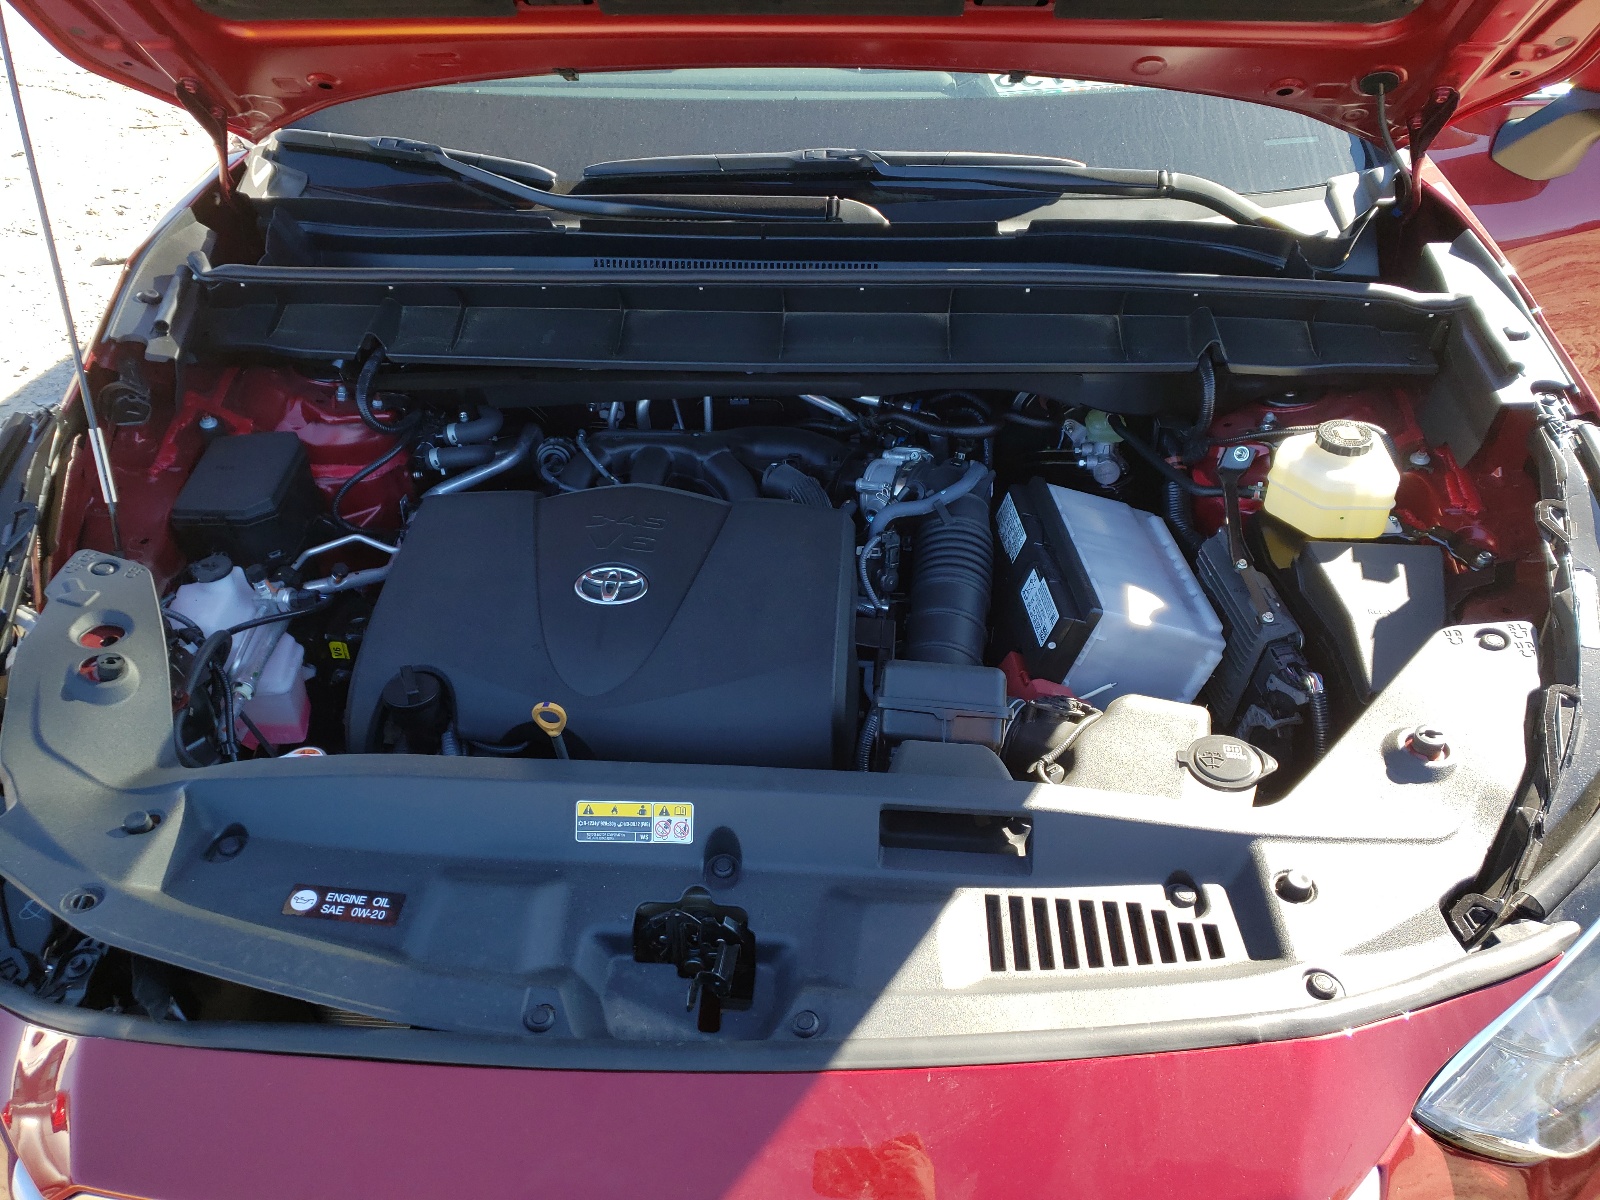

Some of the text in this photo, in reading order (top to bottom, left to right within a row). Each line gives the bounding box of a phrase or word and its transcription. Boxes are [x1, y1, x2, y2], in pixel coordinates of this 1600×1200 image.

[326, 893, 390, 907] ENGINE OIL
[321, 905, 385, 919] SAE 0W-20
